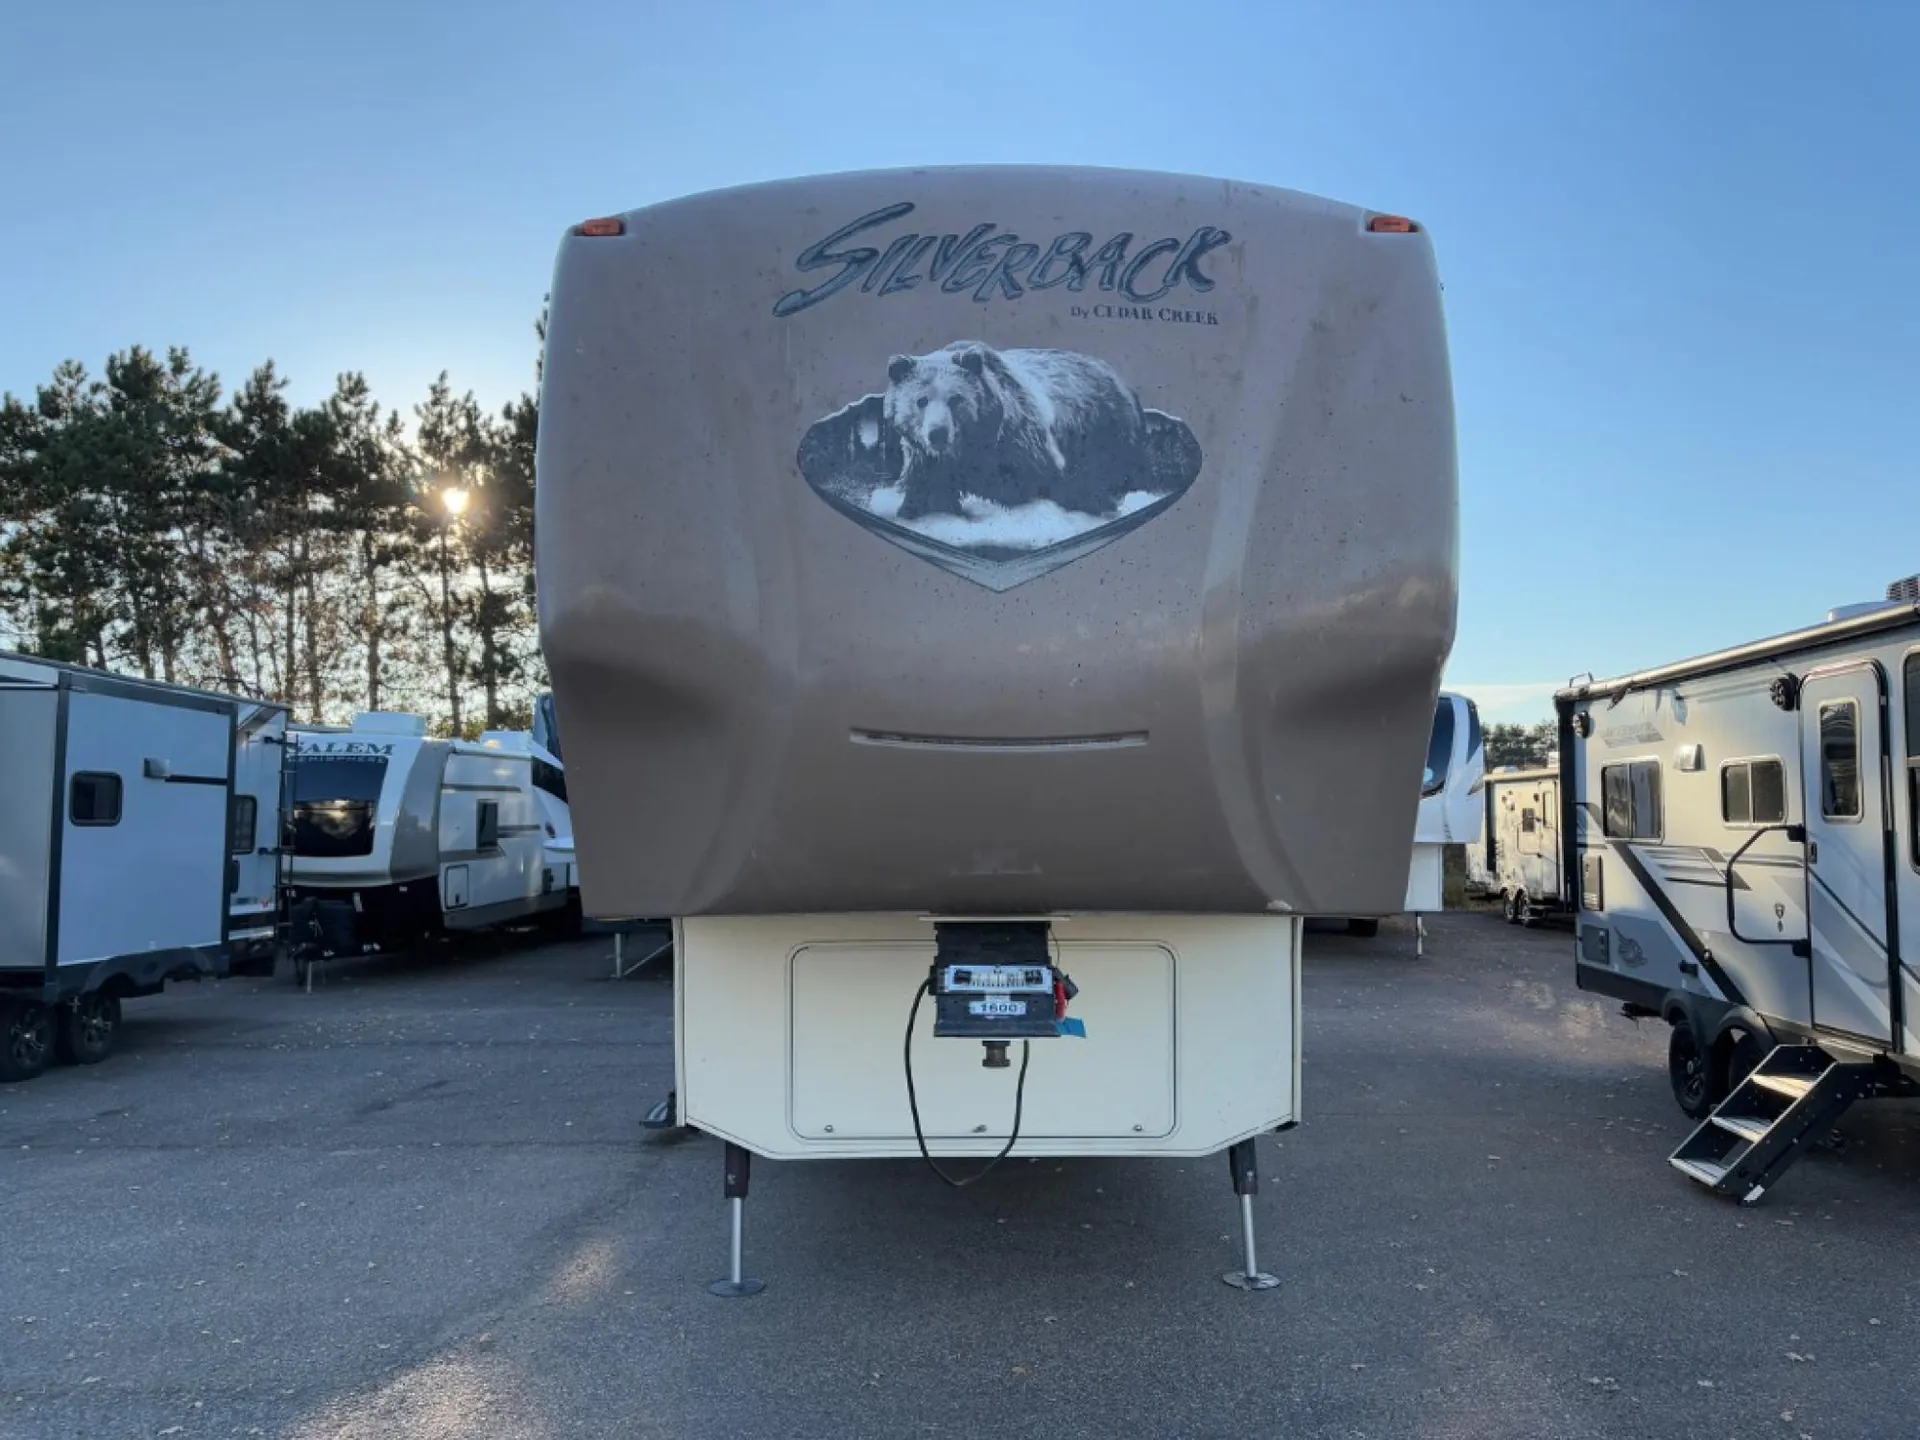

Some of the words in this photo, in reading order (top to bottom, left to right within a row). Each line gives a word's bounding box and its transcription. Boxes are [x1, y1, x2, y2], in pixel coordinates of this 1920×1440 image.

[772, 202, 1232, 317] SILVERBACK
[1093, 304, 1153, 320] CEDAR
[1158, 308, 1218, 325] CREEK
